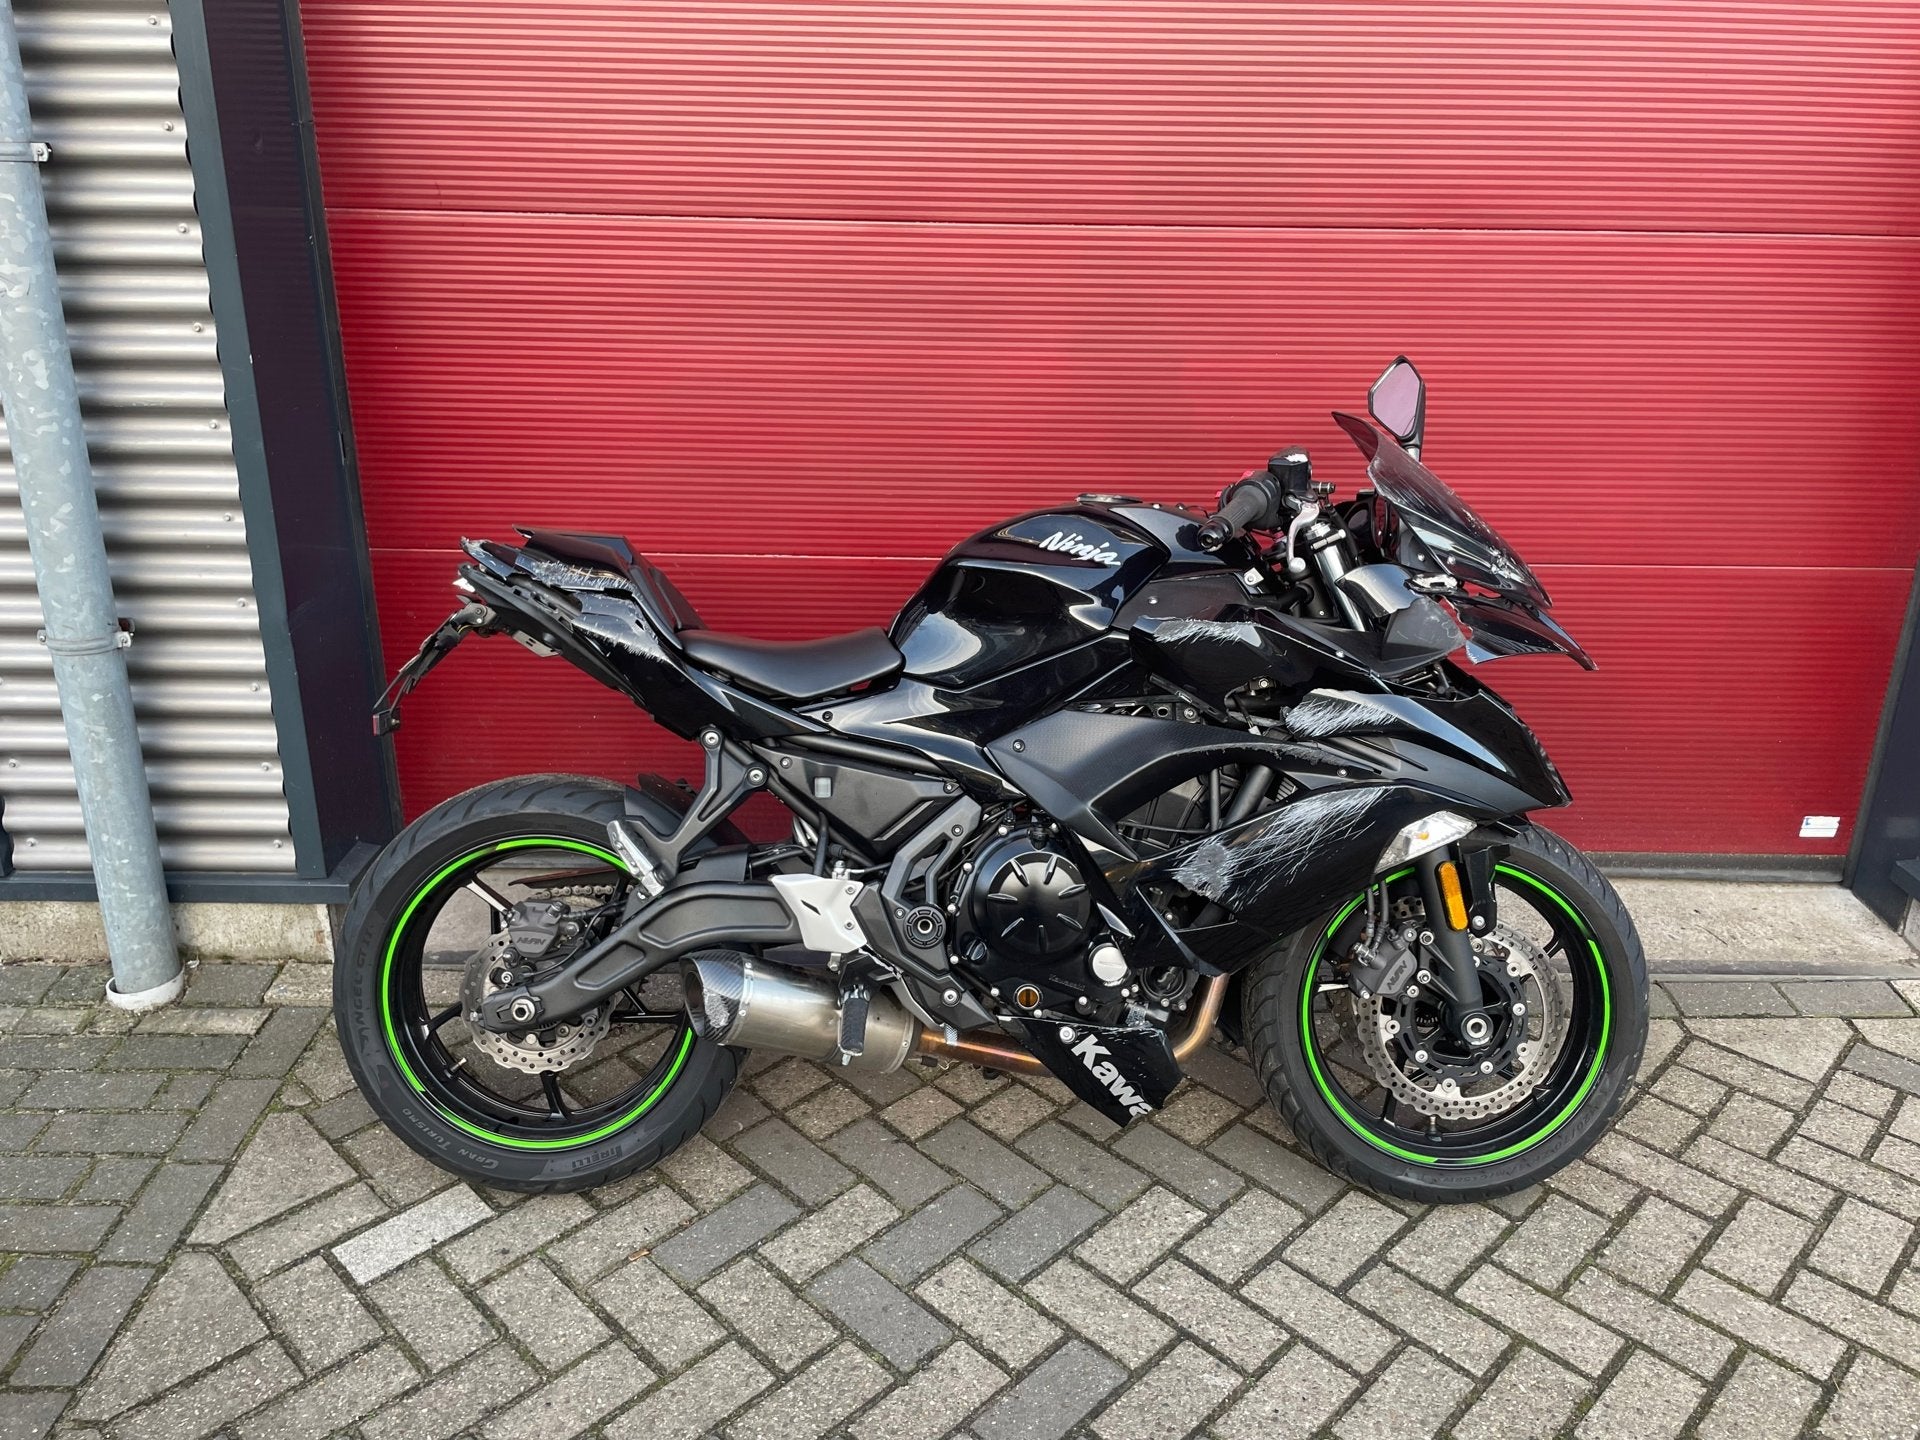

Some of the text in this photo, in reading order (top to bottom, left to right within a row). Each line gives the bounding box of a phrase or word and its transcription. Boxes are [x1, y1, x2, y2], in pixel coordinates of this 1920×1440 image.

[1039, 531, 1121, 566] Ninja
[401, 1107, 500, 1170] GRAN TURISMO
[571, 1144, 623, 1174] PIRELLI
